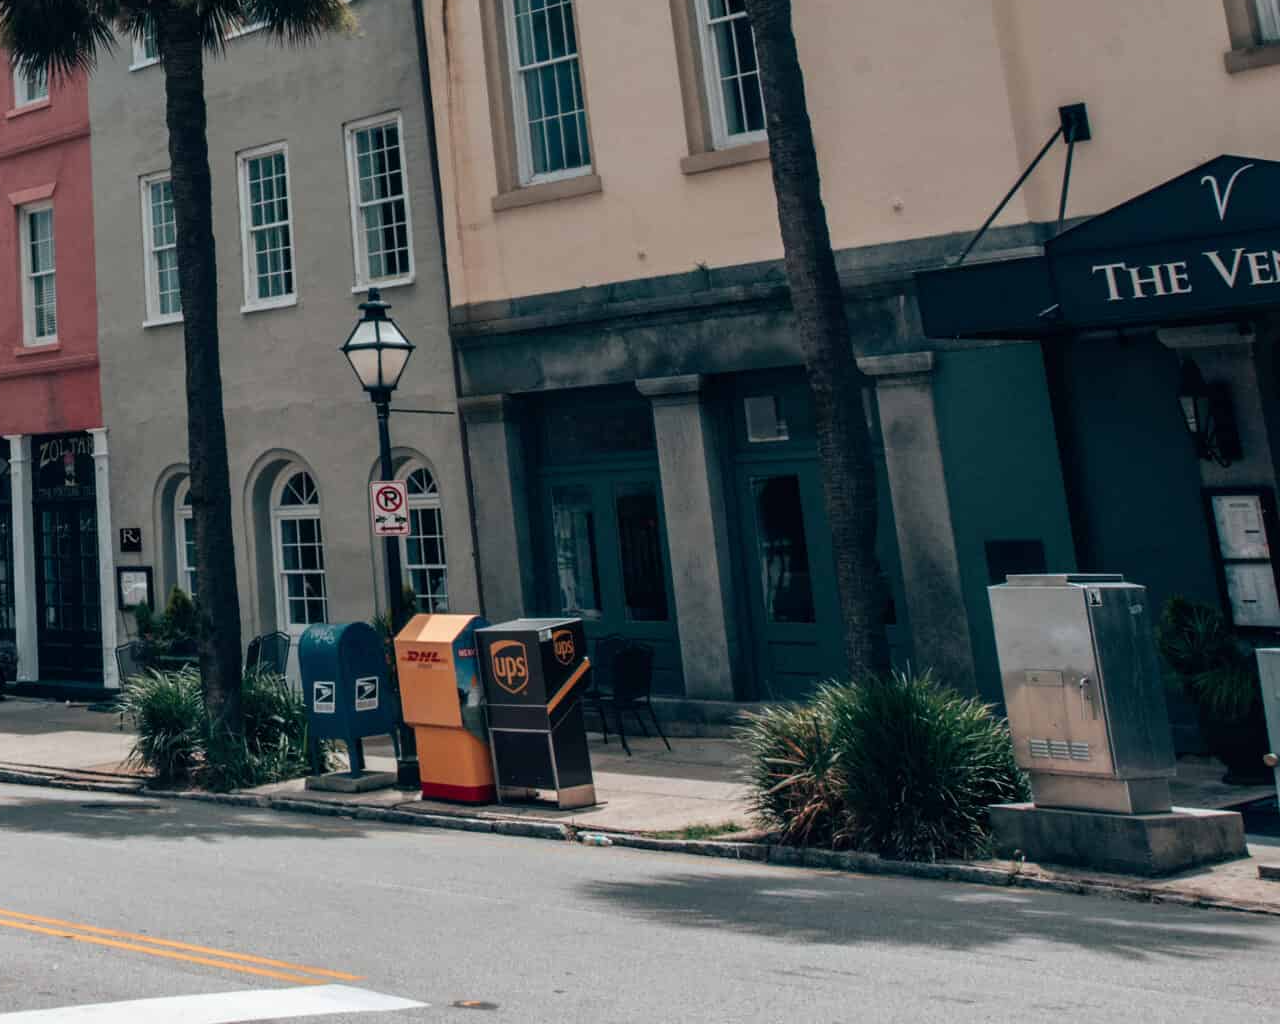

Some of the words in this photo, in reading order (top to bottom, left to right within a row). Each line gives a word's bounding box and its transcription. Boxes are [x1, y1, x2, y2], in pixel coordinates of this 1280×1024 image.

[1201, 164, 1254, 222] V
[1092, 262, 1192, 301] THE
[407, 650, 440, 662] DHL
[554, 641, 573, 659] ups
[495, 656, 526, 685] ups
